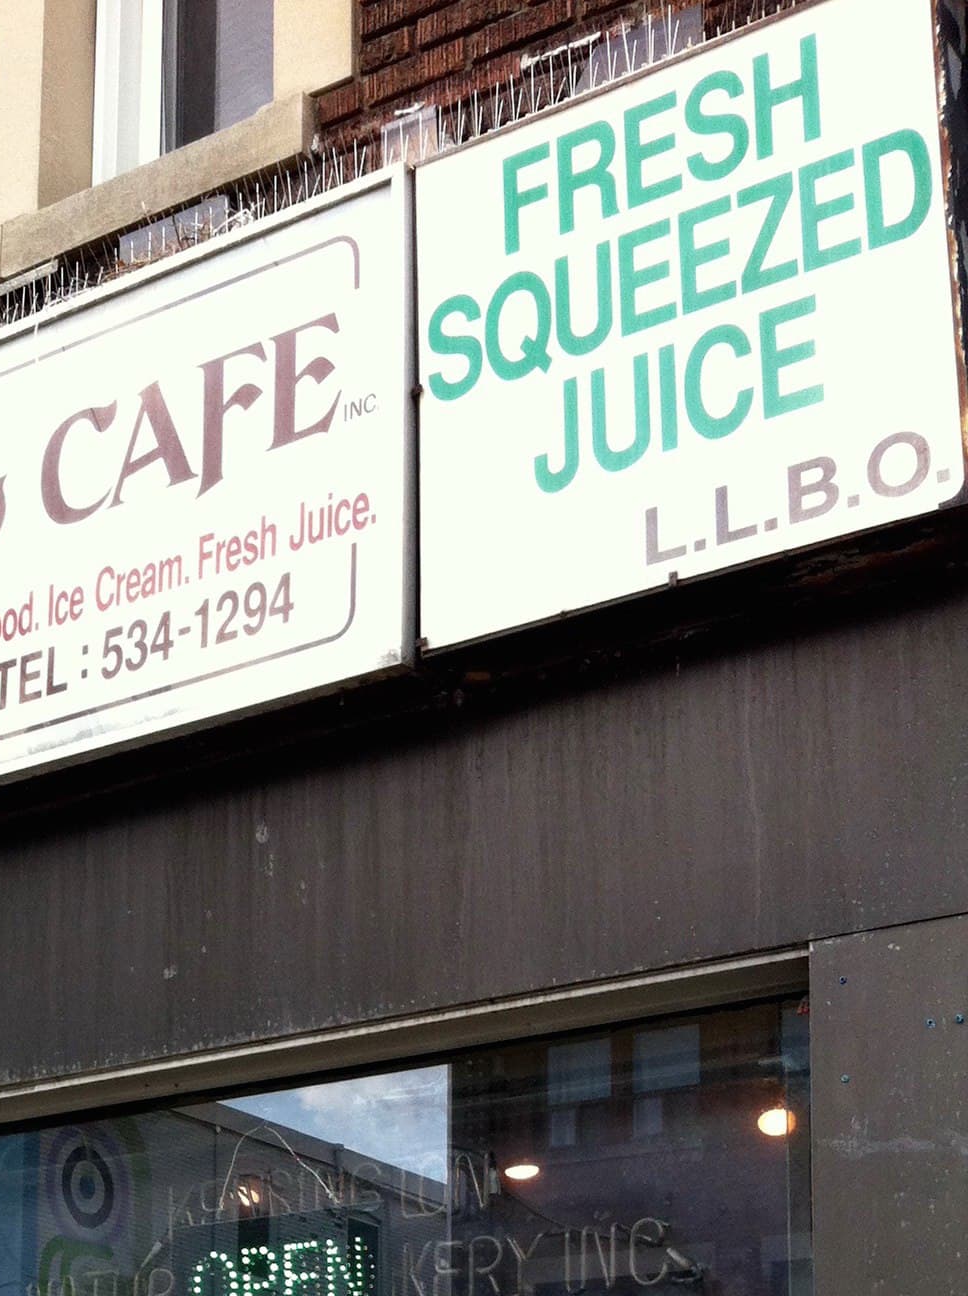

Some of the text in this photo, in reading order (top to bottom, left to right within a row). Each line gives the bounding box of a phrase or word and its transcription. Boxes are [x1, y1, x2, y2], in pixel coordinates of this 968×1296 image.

[502, 33, 822, 256] FRESH
[427, 128, 932, 401] SQUEEZED
[40, 312, 343, 526] CAFE
[534, 294, 824, 493] JUICE
[48, 584, 84, 626] Ice
[95, 554, 190, 612] Cream.
[199, 516, 277, 579] Fresh
[289, 492, 376, 551] Juice.
[644, 431, 951, 566] L.L.B.O.
[101, 572, 295, 680] 534-1294
